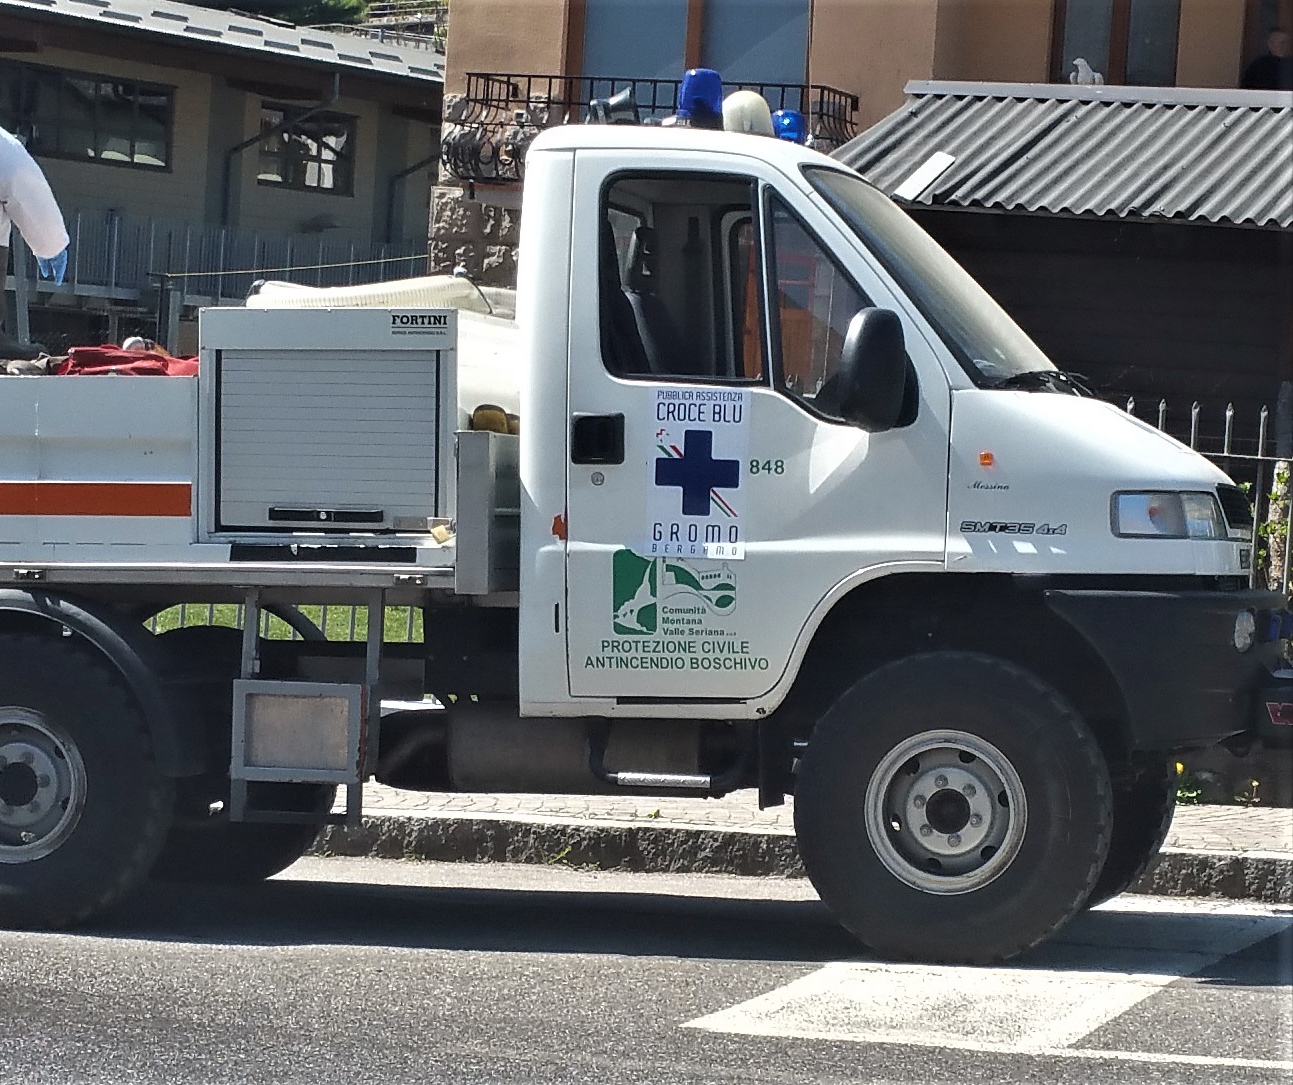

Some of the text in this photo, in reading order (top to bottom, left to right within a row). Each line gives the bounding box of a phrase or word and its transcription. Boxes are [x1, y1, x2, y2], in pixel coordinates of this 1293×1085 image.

[391, 314, 448, 326] FORTINI
[657, 390, 744, 402] PUBBLICA ASSISTENZA
[656, 402, 743, 424] CROCE BLU
[749, 459, 785, 475] 848
[653, 522, 738, 543] GROMO
[960, 521, 1068, 536] SMT35 4x4
[651, 543, 737, 556] BERGAMO
[661, 606, 707, 615] Comunità
[661, 617, 703, 625] Montana
[662, 627, 686, 636] Valle
[688, 628, 725, 637] Seriana
[601, 639, 750, 655] PROTEZIONE CIVILE
[584, 656, 770, 671] ANTINCENDIO BOSCHIVO
